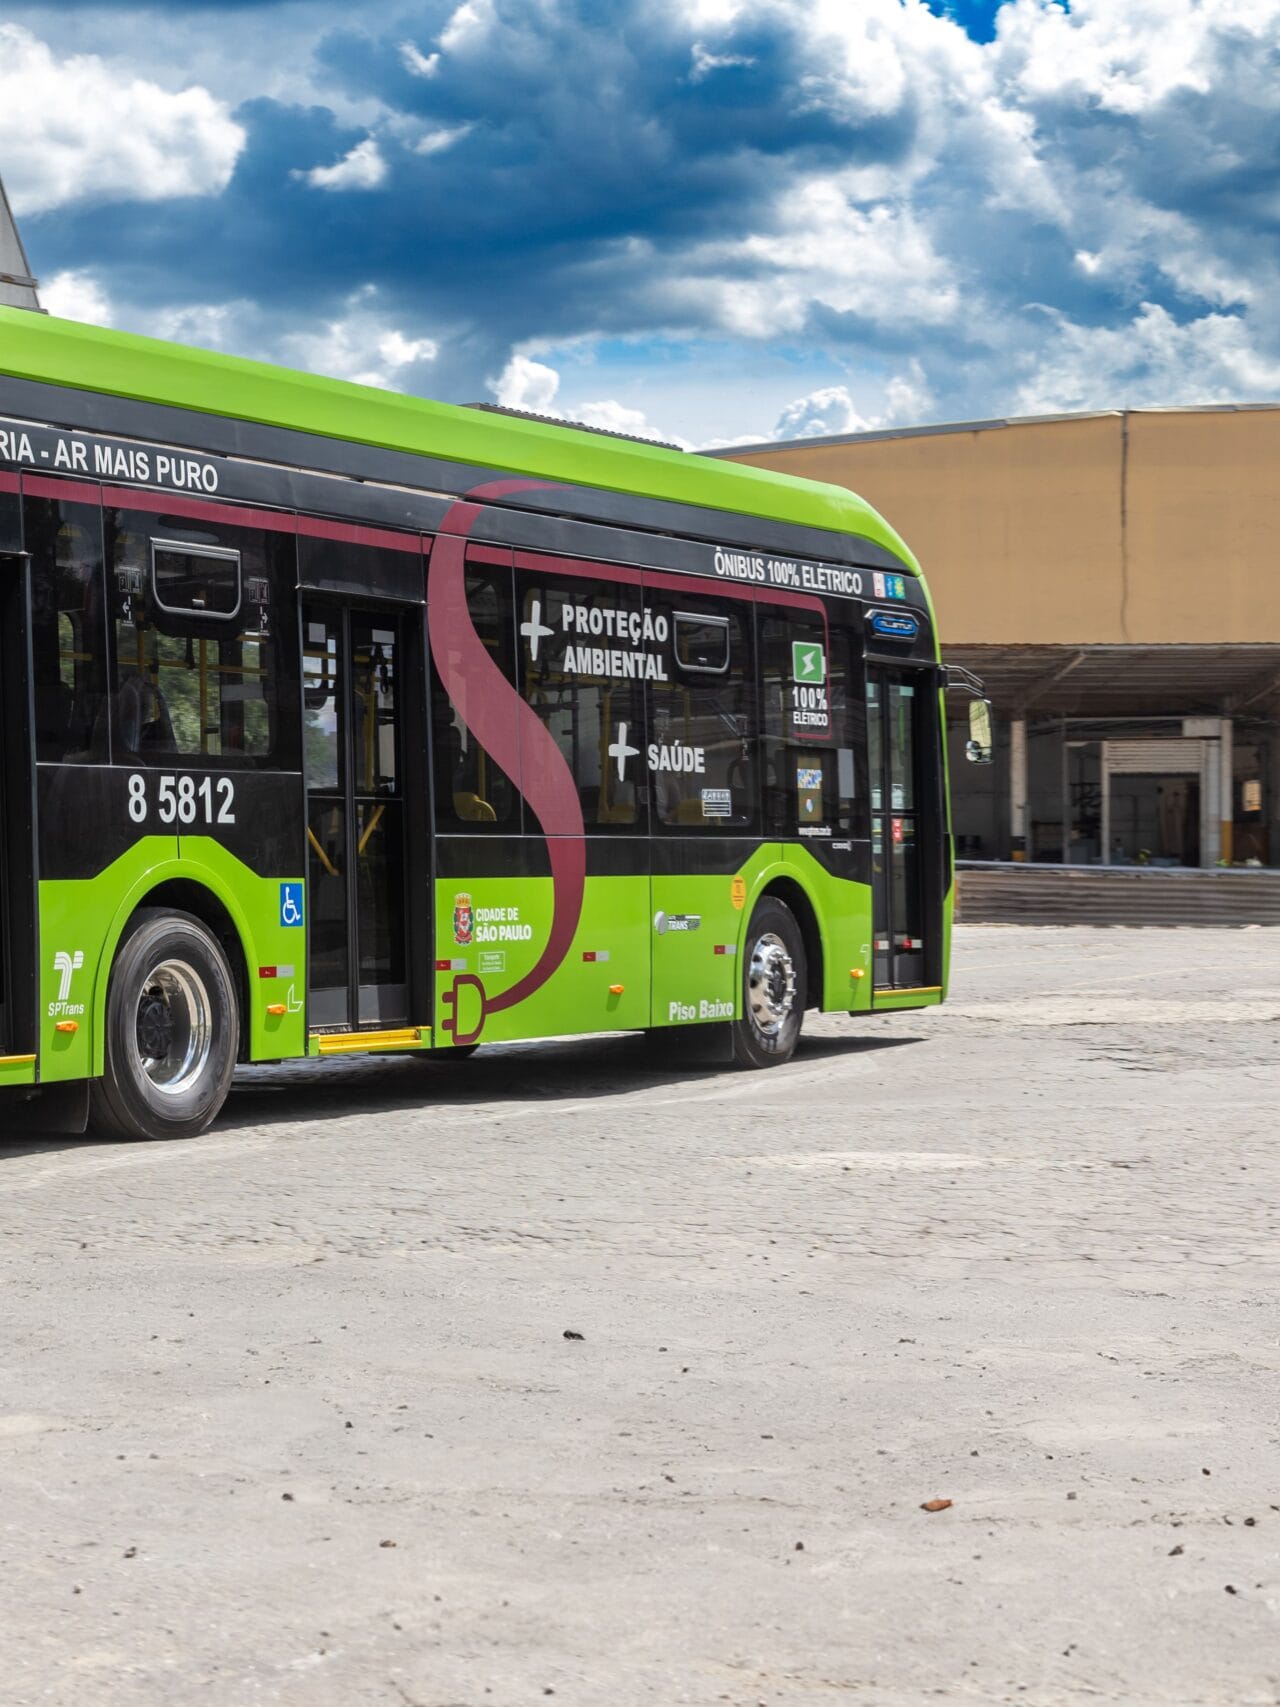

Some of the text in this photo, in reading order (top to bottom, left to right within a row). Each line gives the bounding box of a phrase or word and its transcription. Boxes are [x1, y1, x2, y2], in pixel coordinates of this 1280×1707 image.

[54, 440, 88, 472] AR
[94, 445, 149, 481] MAIS
[157, 455, 218, 492] PURO
[714, 546, 862, 594] ÔNIBUS 100% ELÉTRICO
[562, 603, 668, 646] PROTEÇÃO
[563, 645, 668, 682] AMBIENTAL
[792, 686, 827, 710] 100%
[792, 709, 828, 727] ELÉTRICO
[647, 738, 706, 774] SAÚDE
[128, 775, 236, 824] 8 5812
[476, 907, 519, 922] CIDADE DE
[476, 923, 532, 942] SÃO PAULO
[48, 1002, 84, 1017] SPTrans
[669, 999, 734, 1021] Piso Baixo
